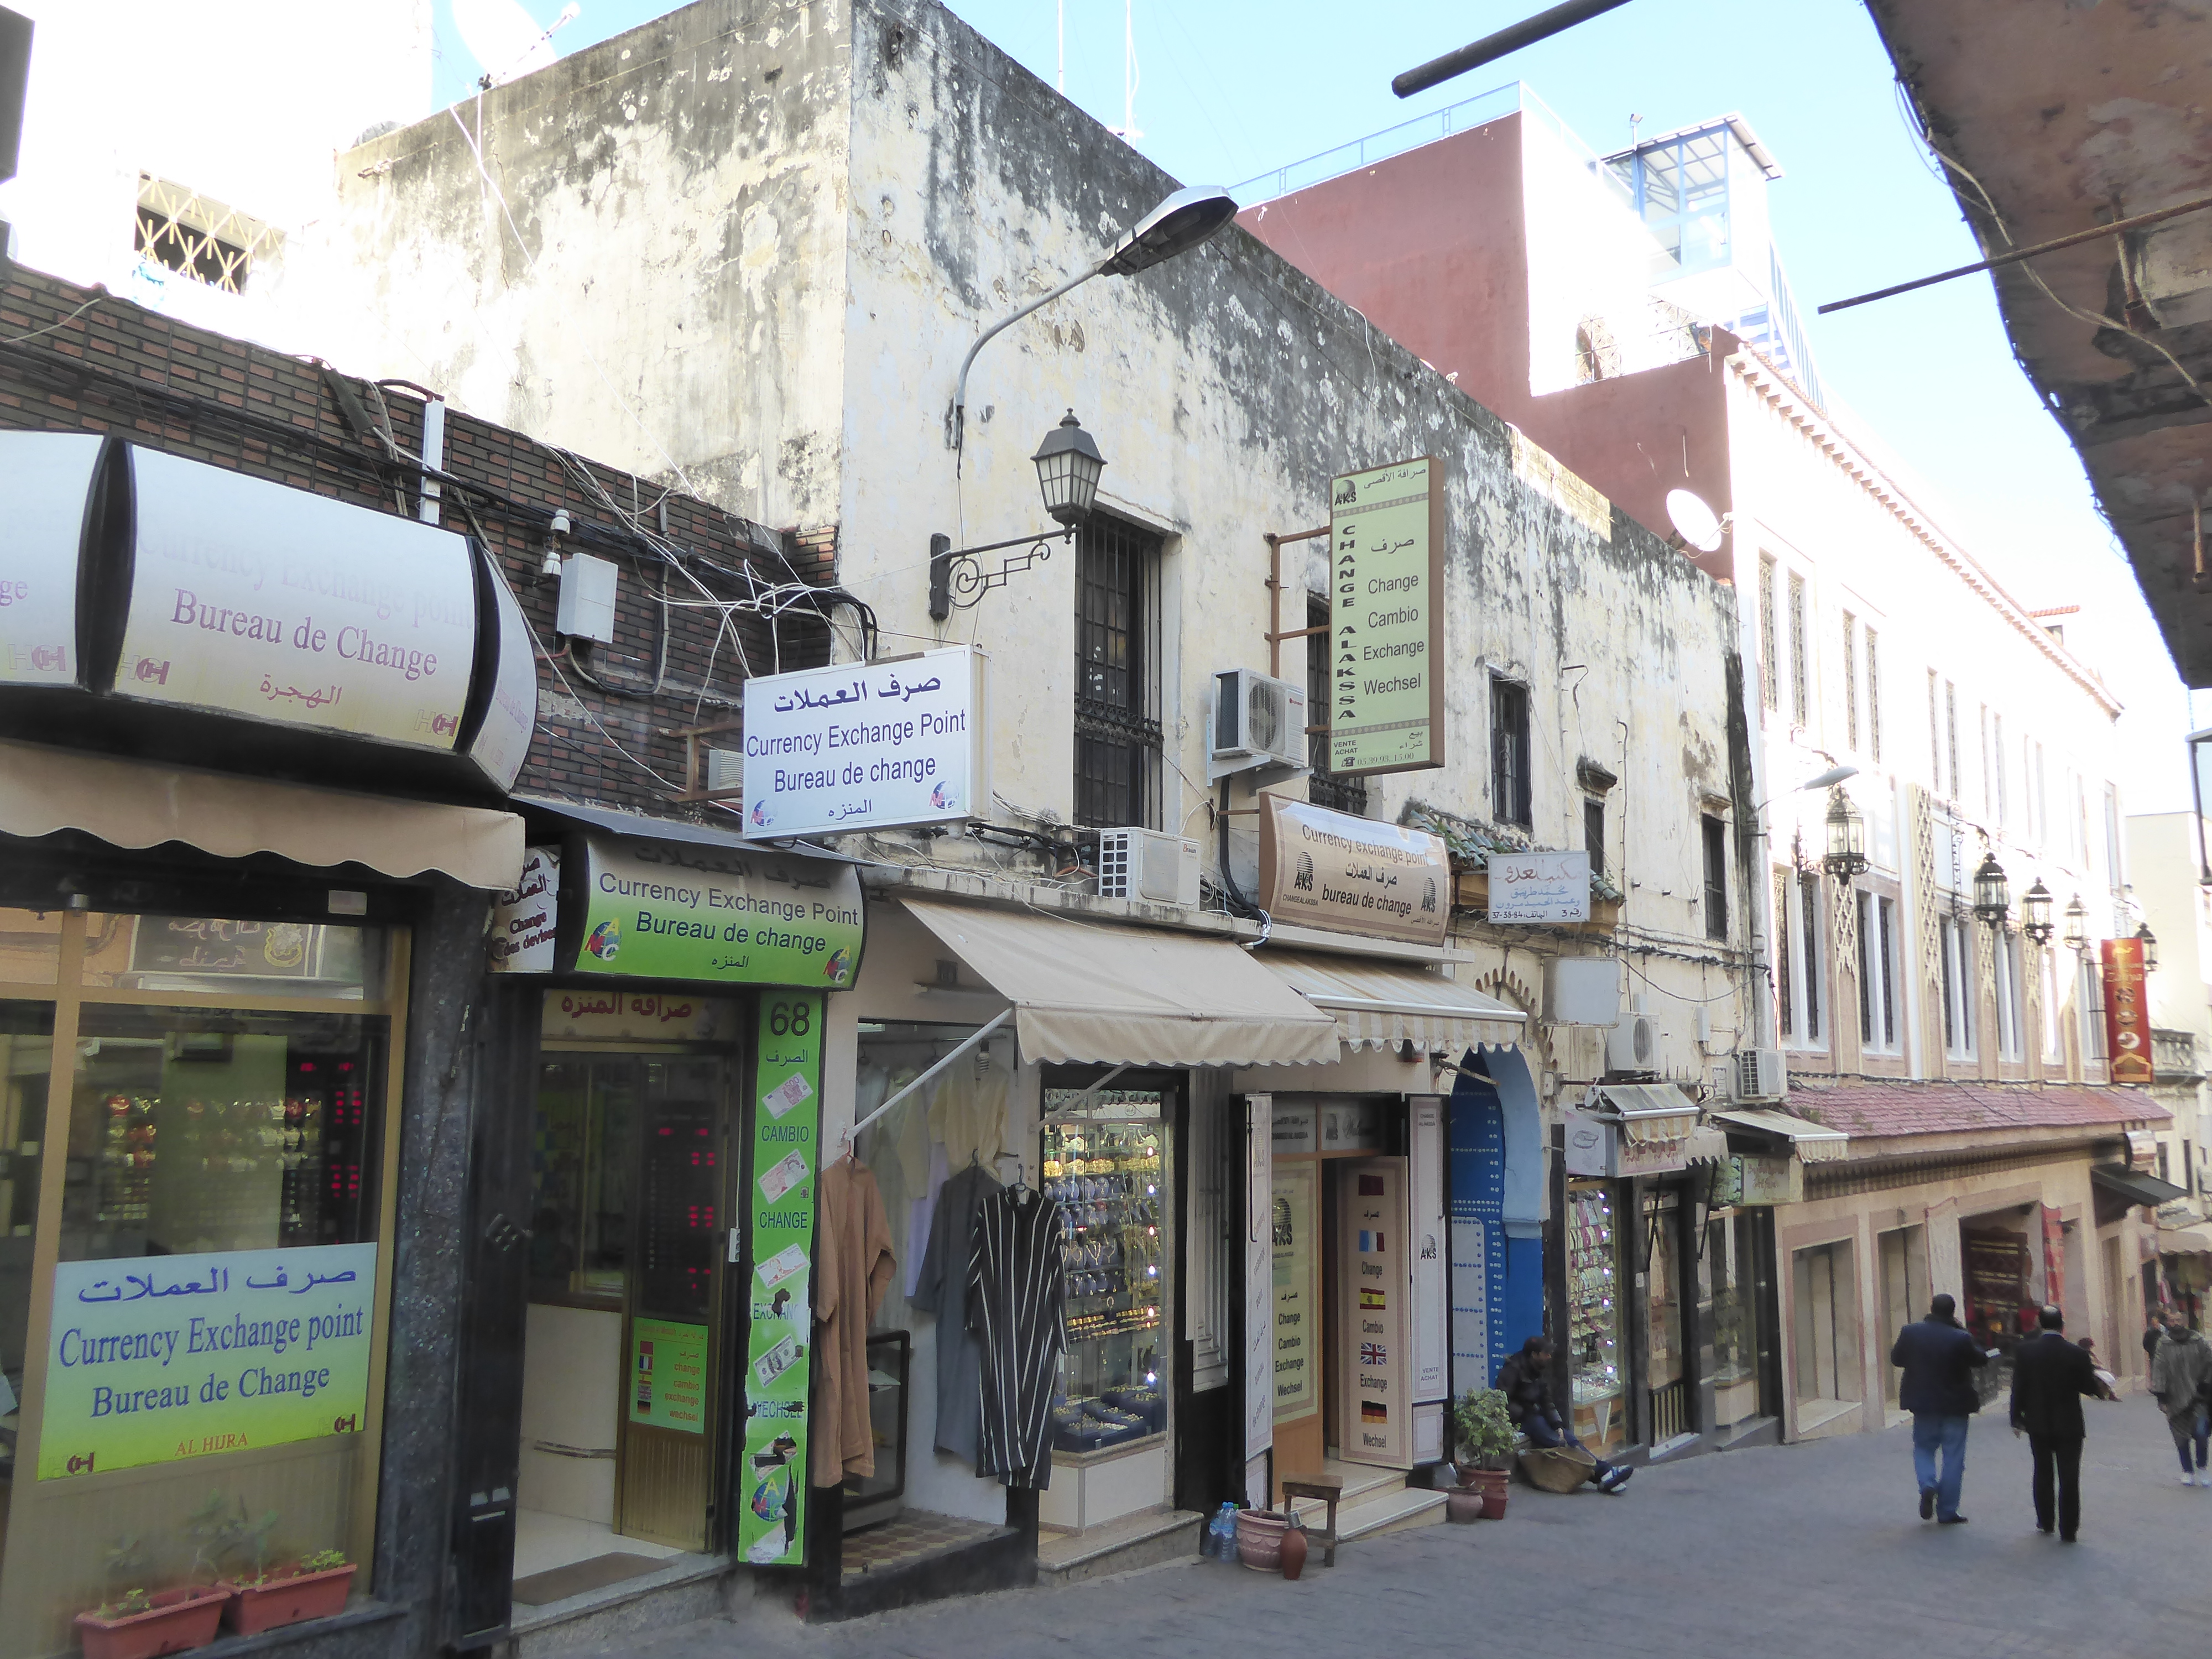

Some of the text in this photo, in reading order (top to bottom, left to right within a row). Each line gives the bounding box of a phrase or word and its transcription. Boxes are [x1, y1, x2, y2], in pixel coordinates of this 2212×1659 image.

[1334, 491, 1357, 506] AKS
[1371, 539, 1415, 554] صرف
[281, 549, 406, 621] Exchange
[1368, 575, 1419, 594] Change
[1368, 605, 1419, 628] Cambio
[170, 588, 438, 681] Bureau de Change
[1363, 640, 1425, 661] Exchange
[259, 672, 343, 709] الهجرة
[774, 672, 941, 712] صرف العملات
[1364, 672, 1421, 696] Wechsel
[747, 708, 966, 757] Currency Exchange Point
[1334, 747, 1358, 755] ACHAT
[774, 757, 936, 792] Bureau de change
[827, 799, 872, 821] المنزه
[1302, 823, 1430, 867] Currency exchange point
[1293, 871, 1313, 892] AKS
[1345, 862, 1397, 889] صرف العملات
[599, 872, 859, 926] Currency Exchange Point
[1322, 884, 1412, 918] bureau de change
[1421, 895, 1436, 912] AKS
[509, 911, 547, 935] Change
[635, 911, 827, 955] Bureau de change
[770, 1001, 810, 1036] 68
[766, 1049, 808, 1067] الصرف
[761, 1125, 810, 1142] CAMBIO
[759, 1211, 808, 1229] CHANGE
[1420, 1248, 1437, 1260] AKS
[1361, 1261, 1383, 1279] Change
[78, 1265, 357, 1303] صرف العملات
[1278, 1313, 1301, 1327] Change
[1362, 1319, 1384, 1334] Cambio
[59, 1303, 364, 1369] Currency Exchange point
[1278, 1336, 1301, 1350] Cambio
[674, 1363, 701, 1376] change
[1275, 1357, 1304, 1373] Exchange
[90, 1365, 330, 1418] Bureau de Change
[673, 1380, 700, 1390] cambio
[1277, 1380, 1303, 1397] Wechsel
[1360, 1374, 1387, 1392] Exchange
[664, 1392, 700, 1407] exchange
[669, 1410, 698, 1422] wechsel
[175, 1432, 248, 1457] AL HURA
[1362, 1432, 1387, 1449] Wechsel
